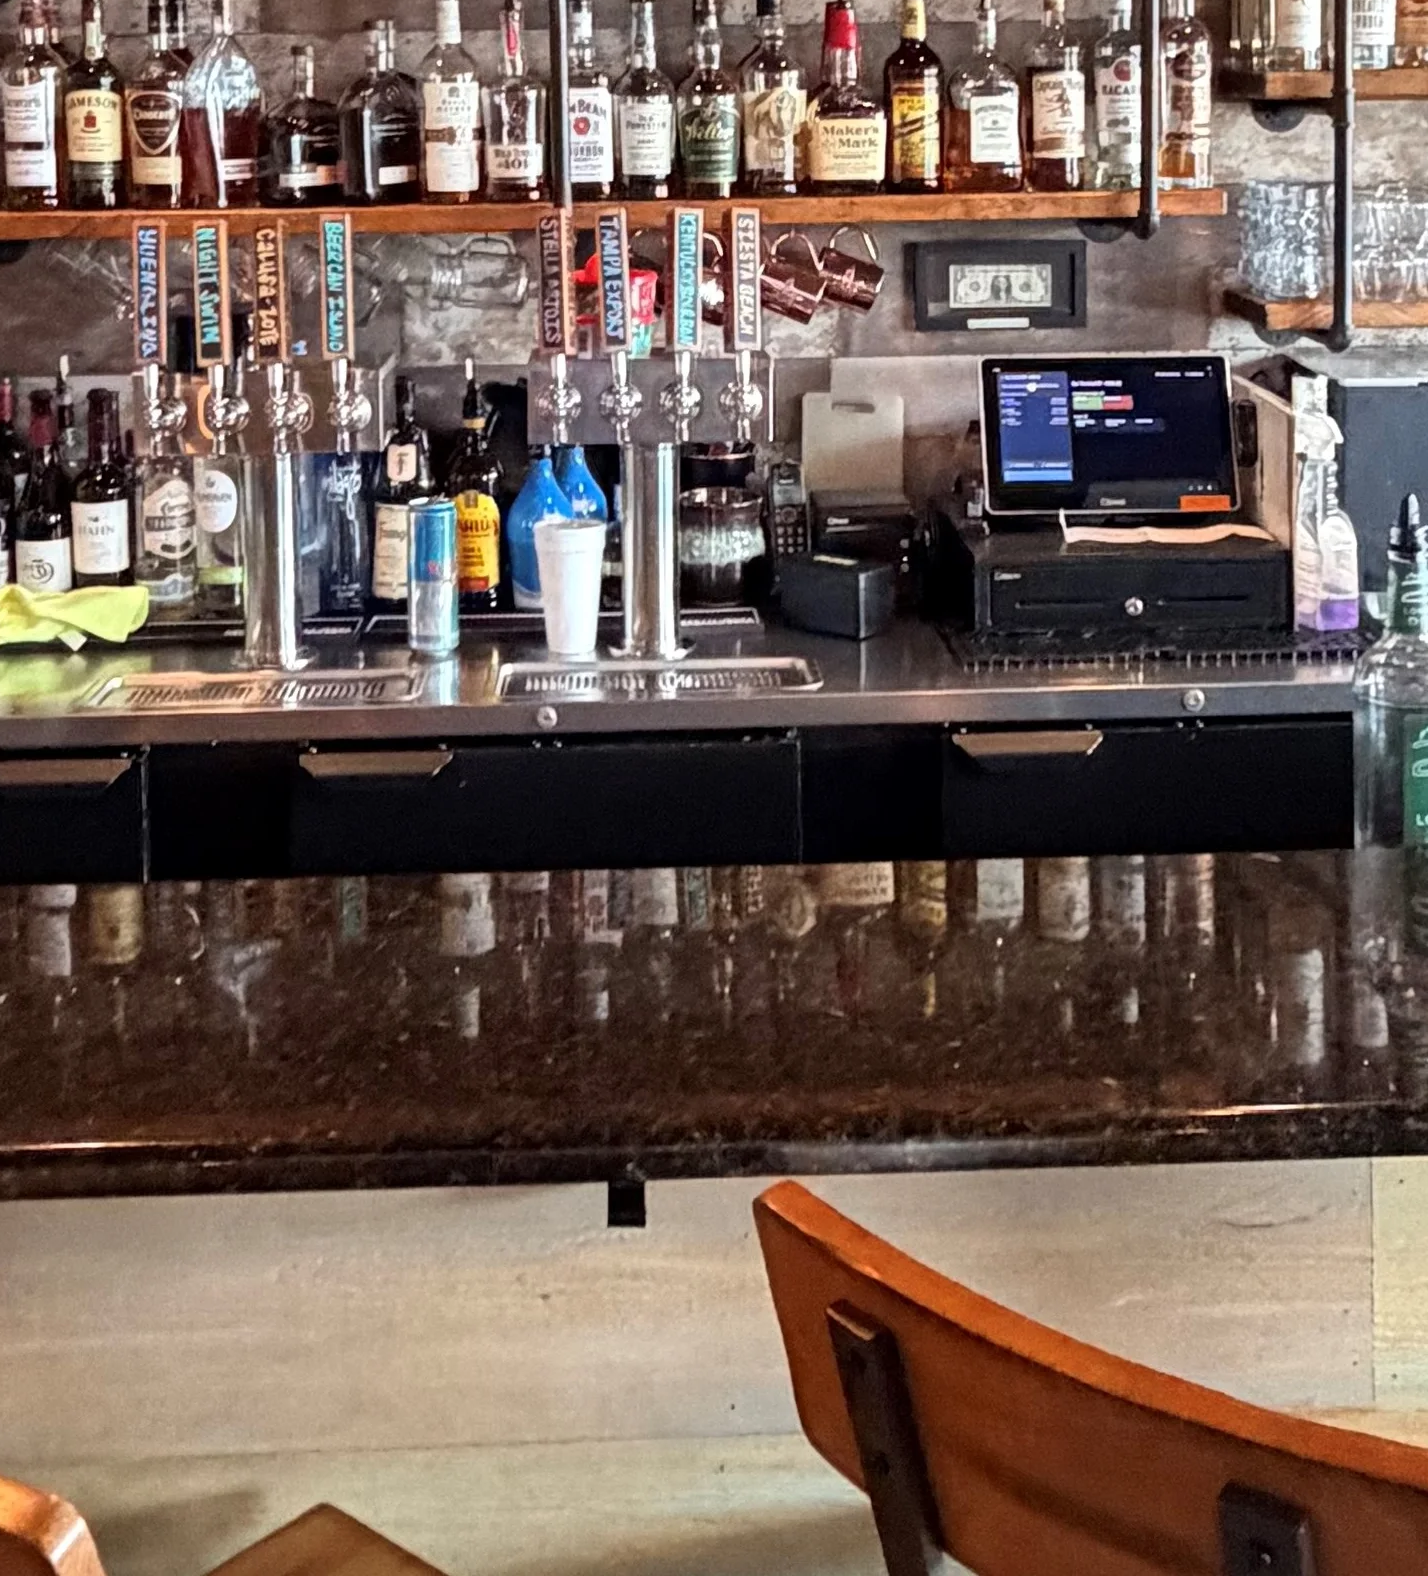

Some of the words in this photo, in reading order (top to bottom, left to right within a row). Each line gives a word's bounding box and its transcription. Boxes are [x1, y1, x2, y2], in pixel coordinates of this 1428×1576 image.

[821, 125, 880, 138] Maker's
[837, 138, 878, 149] Mark
[195, 226, 219, 285] NIGHT
[598, 217, 622, 277] TAMPA
[737, 217, 755, 281] SIESTA
[604, 280, 624, 340] EXPORT
[738, 283, 755, 336] BEACH
